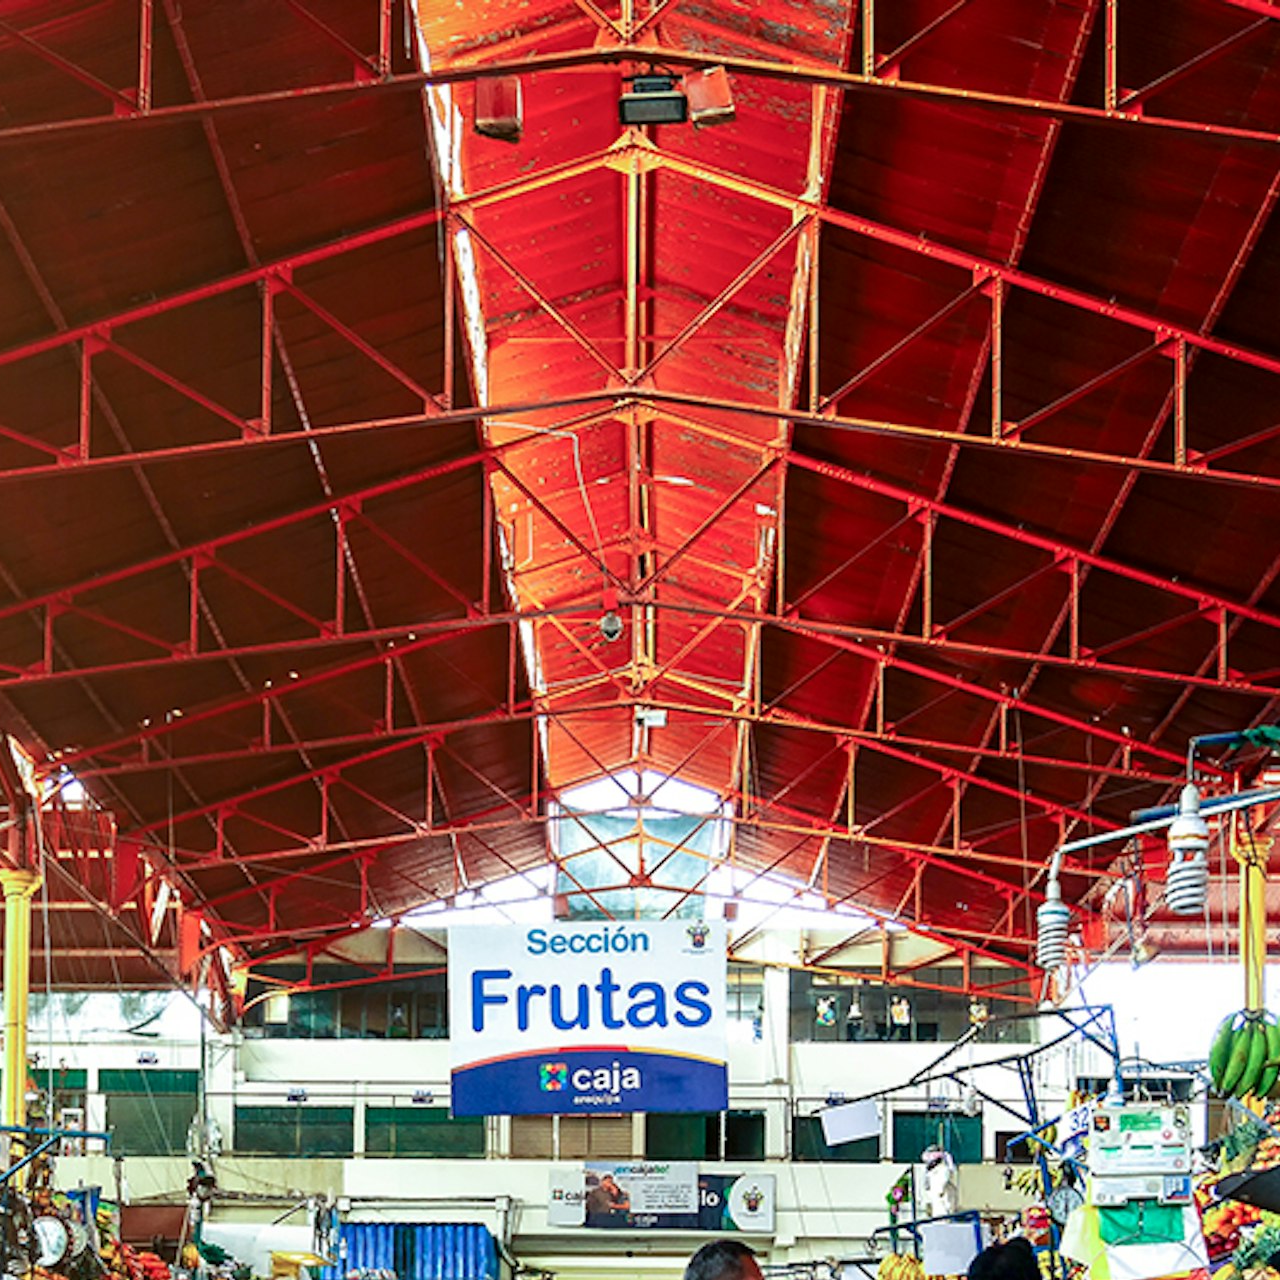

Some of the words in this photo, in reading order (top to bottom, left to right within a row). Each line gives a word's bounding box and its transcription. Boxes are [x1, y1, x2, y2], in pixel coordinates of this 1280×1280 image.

[527, 926, 649, 954] Sección
[471, 967, 713, 1032] Frutas
[572, 1061, 642, 1094] caja
[1070, 1106, 1090, 1132] 32
